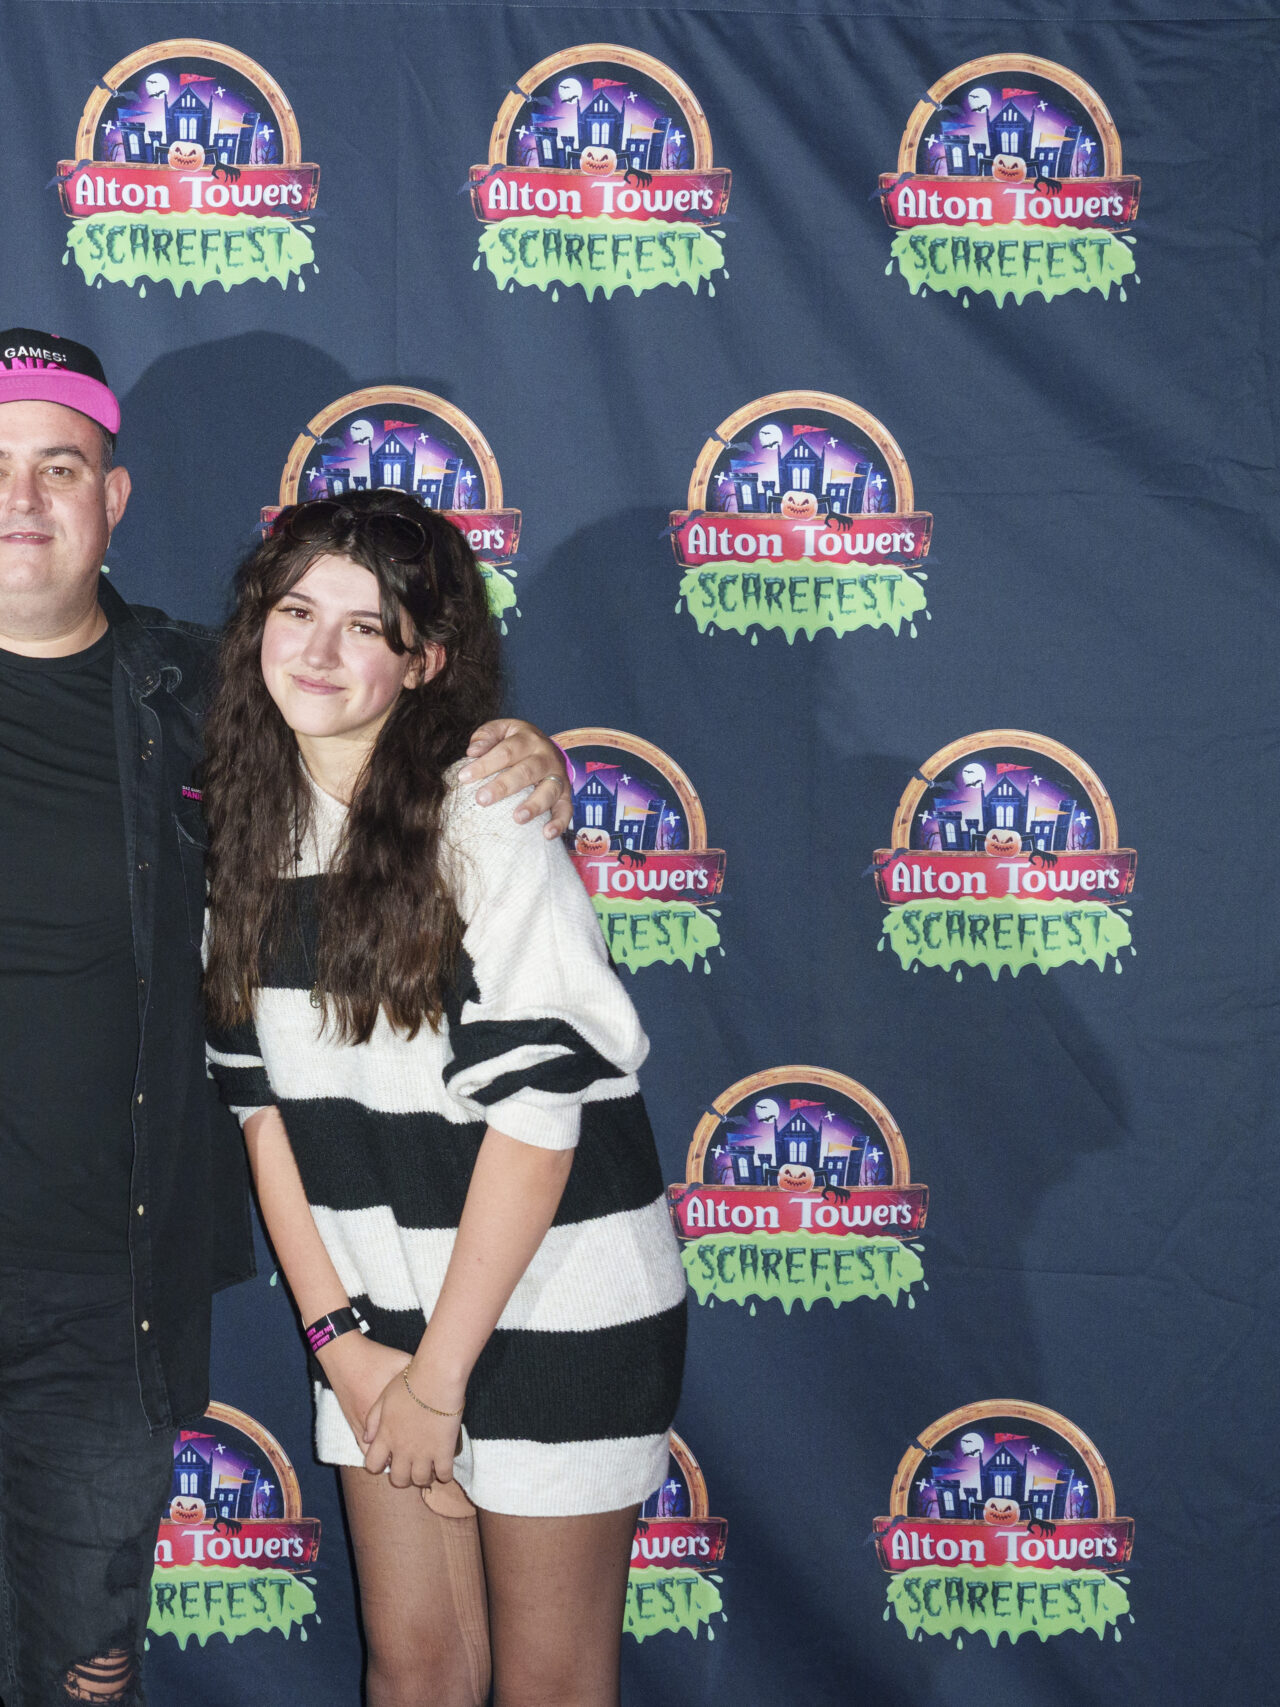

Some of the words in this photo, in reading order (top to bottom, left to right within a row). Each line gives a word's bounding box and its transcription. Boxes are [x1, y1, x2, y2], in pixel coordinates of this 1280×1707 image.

[76, 174, 170, 208] Alton
[179, 175, 302, 209] Towers
[488, 178, 581, 213] Alton
[591, 181, 713, 213] Towers
[898, 186, 992, 220] Alton
[1003, 188, 1123, 220] Towers
[87, 225, 290, 266] SCAREFEST
[497, 229, 696, 271] SCAREFEST
[909, 235, 1111, 276] SCAREFEST
[460, 528, 505, 550] ers
[688, 524, 783, 556] Alton
[792, 524, 914, 556] Towers
[698, 573, 903, 613] SCAREFEST
[586, 861, 708, 893] Towers
[892, 862, 986, 893] Alton
[996, 862, 1119, 893] Towers
[902, 910, 1106, 950] SCAREFEST
[687, 1197, 779, 1227] Alton
[789, 1198, 911, 1227] Towers
[697, 1244, 899, 1285] SCAREFEST
[181, 1529, 304, 1561] Towers
[892, 1530, 985, 1561] Alton
[995, 1531, 1116, 1561] Towers
[902, 1577, 1105, 1622] SCAREFEST
